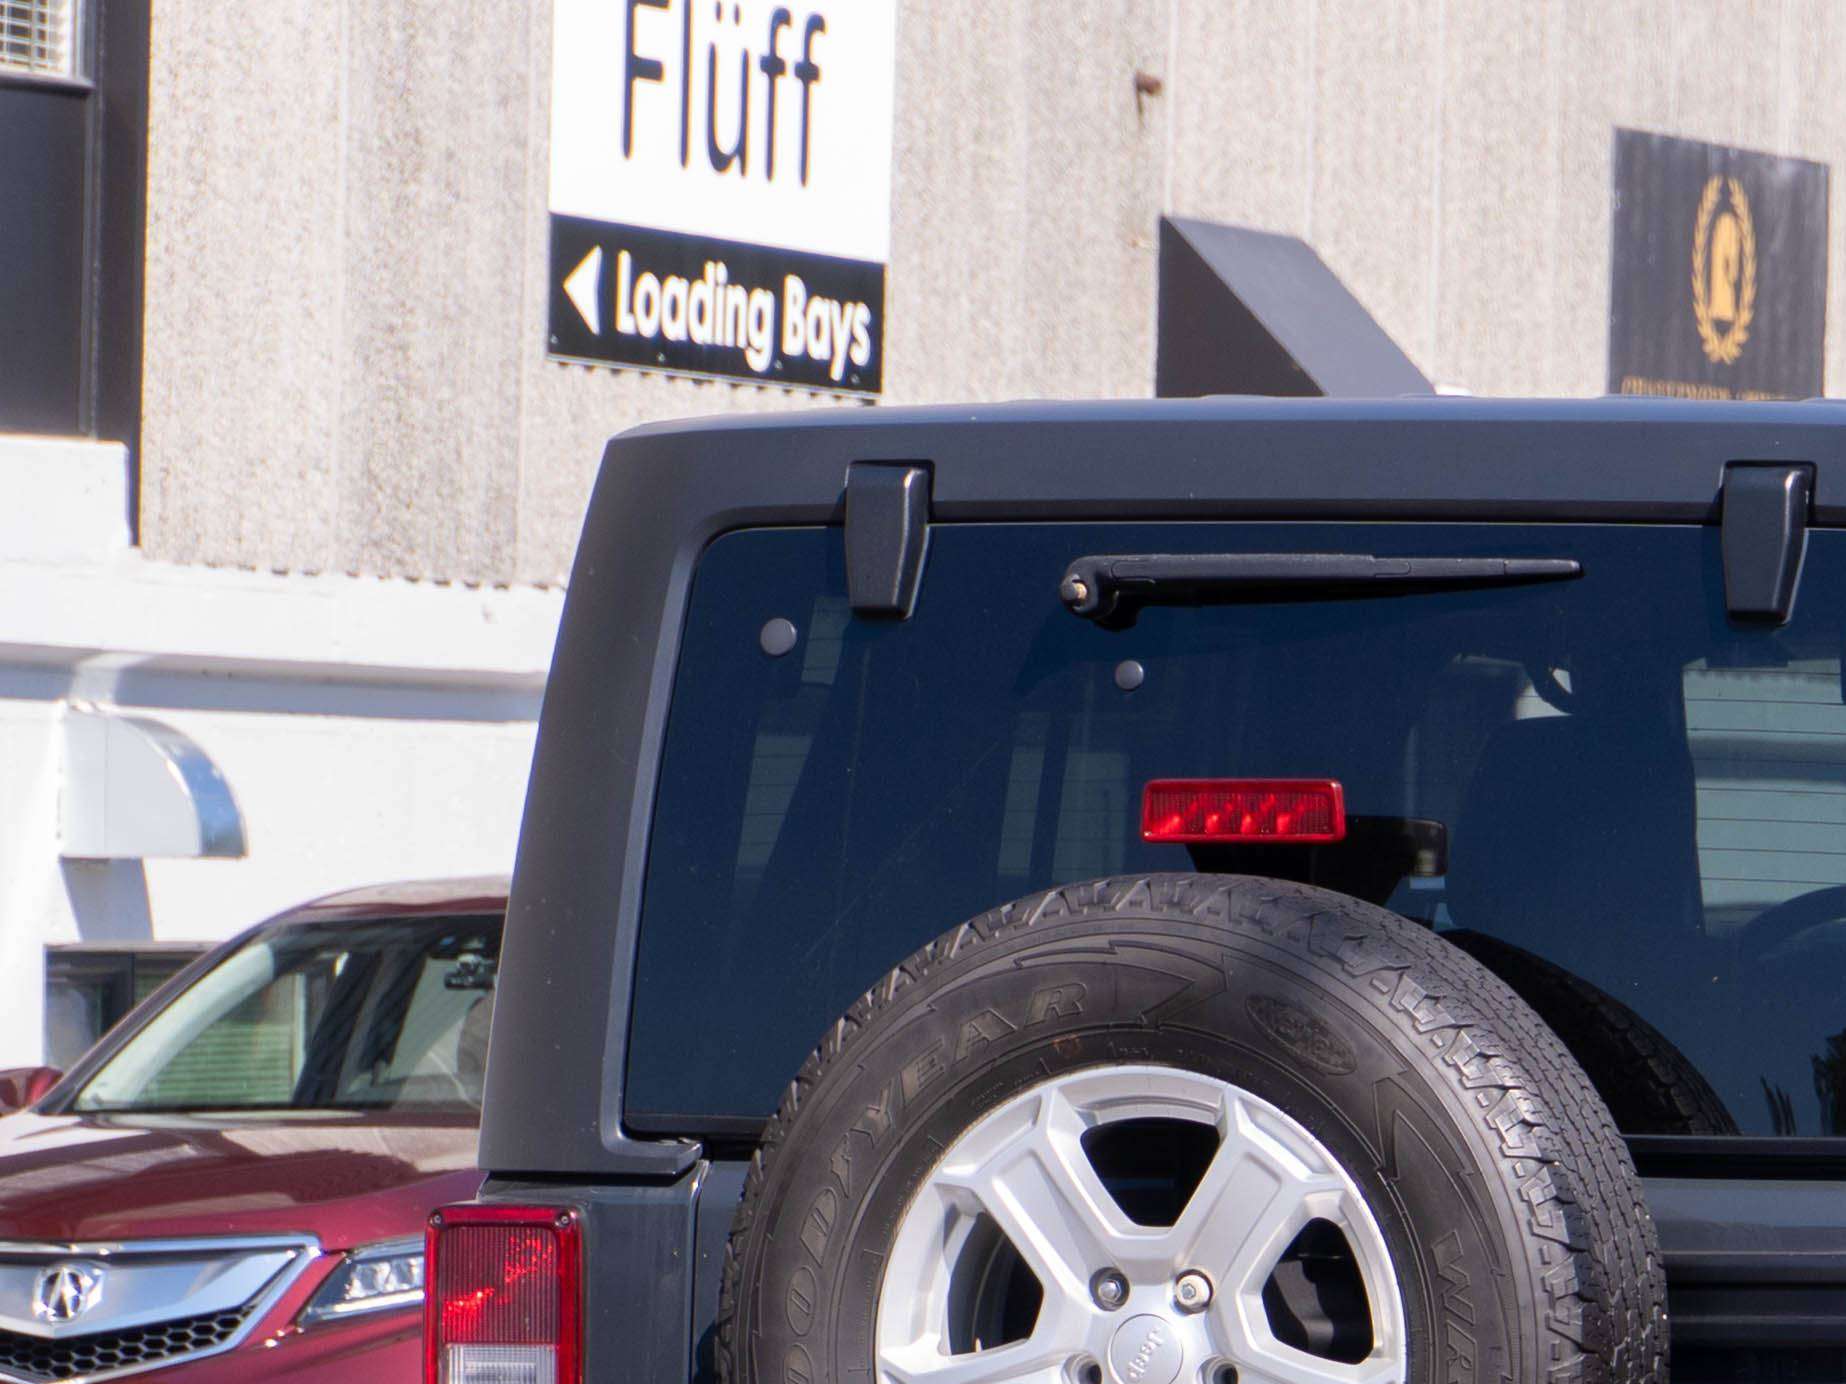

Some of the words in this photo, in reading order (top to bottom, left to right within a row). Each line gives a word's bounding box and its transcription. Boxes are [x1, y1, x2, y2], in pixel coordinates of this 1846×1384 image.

[621, 0, 826, 188] Flüff
[616, 249, 774, 372] Loading
[783, 274, 871, 382] Bays
